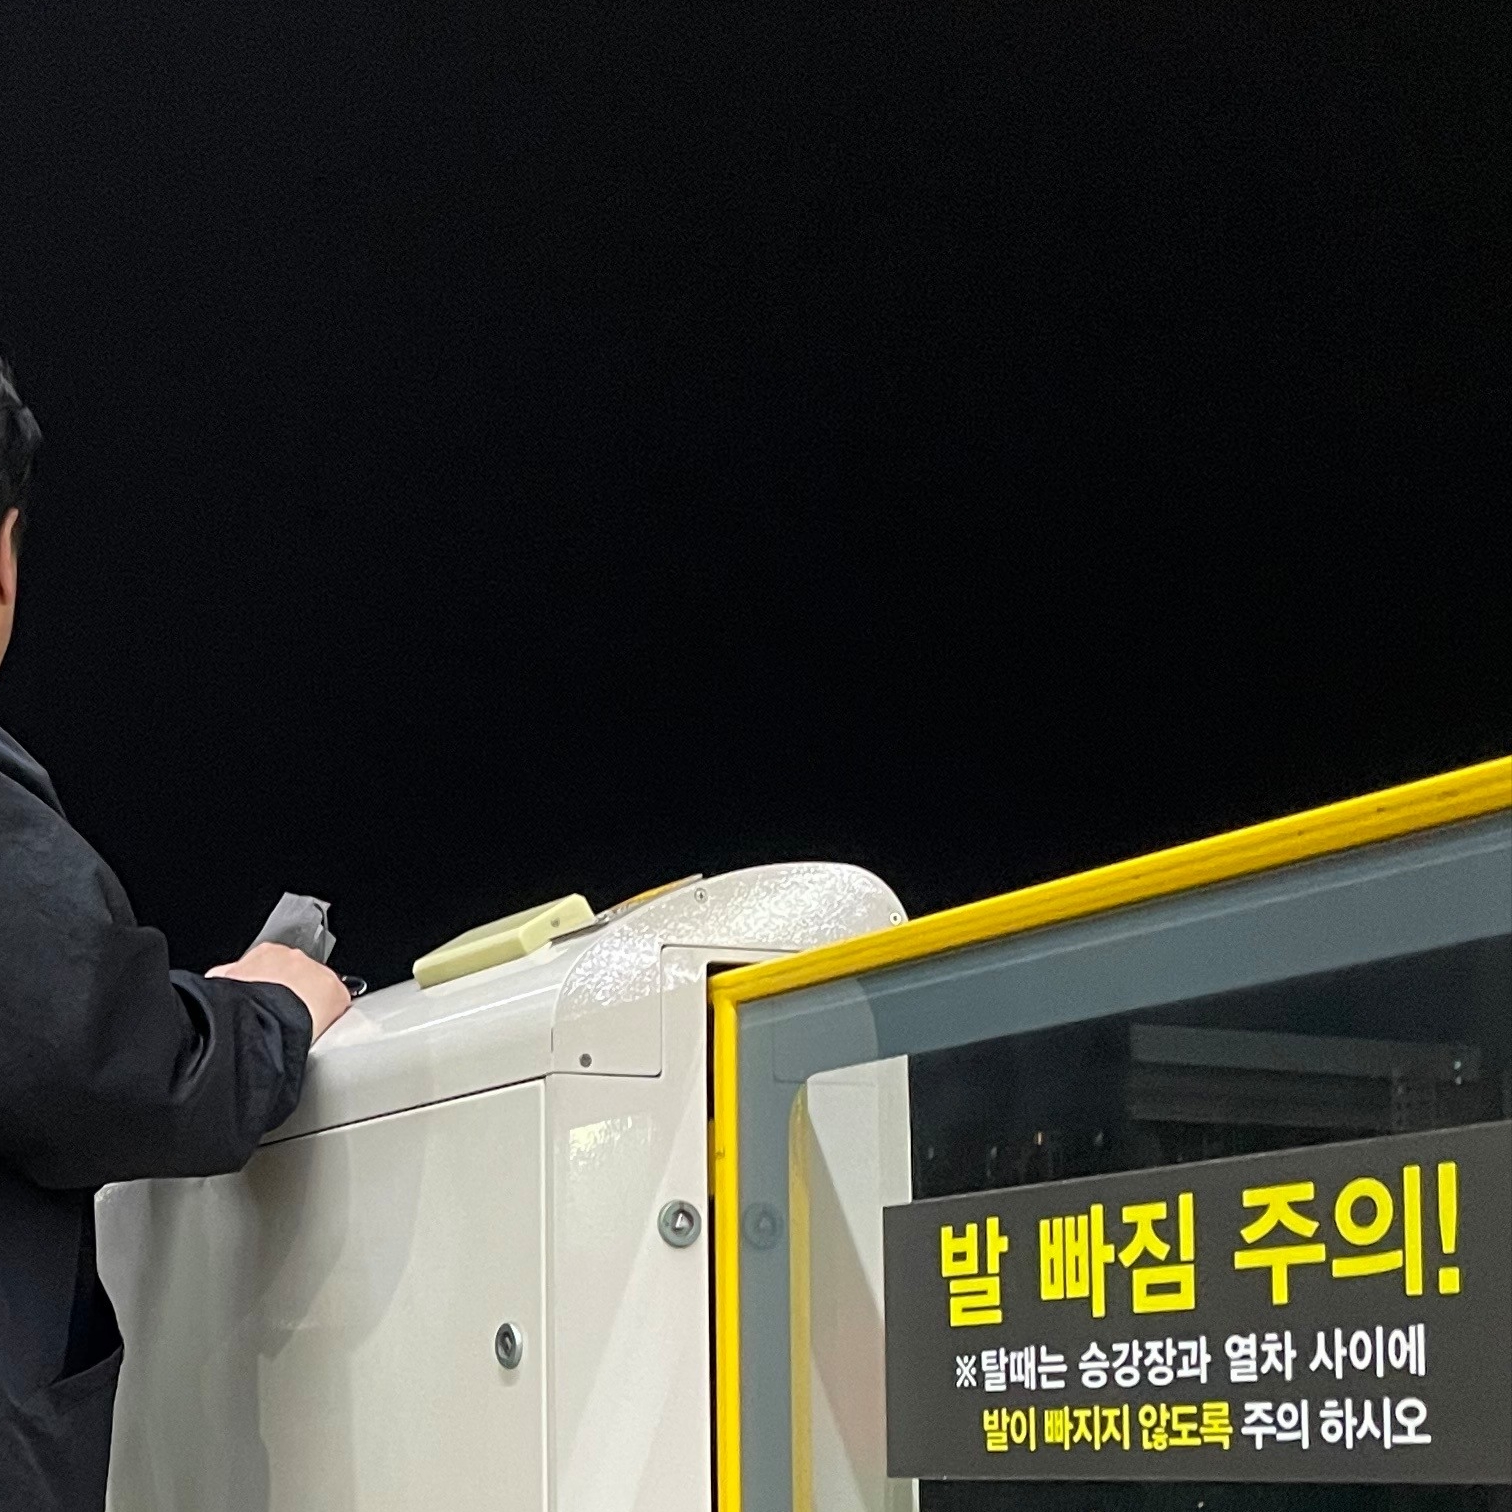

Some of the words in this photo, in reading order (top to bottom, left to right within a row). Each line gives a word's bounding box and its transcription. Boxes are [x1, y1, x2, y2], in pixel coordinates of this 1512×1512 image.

[940, 1216, 1009, 1327] 발
[1038, 1192, 1196, 1319] 빠짐
[1233, 1161, 1461, 1306] 주의!
[1078, 1335, 1212, 1389] 승강장과
[1224, 1330, 1298, 1383] 열차
[1308, 1322, 1426, 1380] 사이에
[982, 1405, 1037, 1452] 발이
[1044, 1403, 1131, 1451] 빠지지
[1138, 1401, 1234, 1452] 않도록
[1240, 1398, 1310, 1451] 주의
[1319, 1395, 1432, 1450] 하시오
